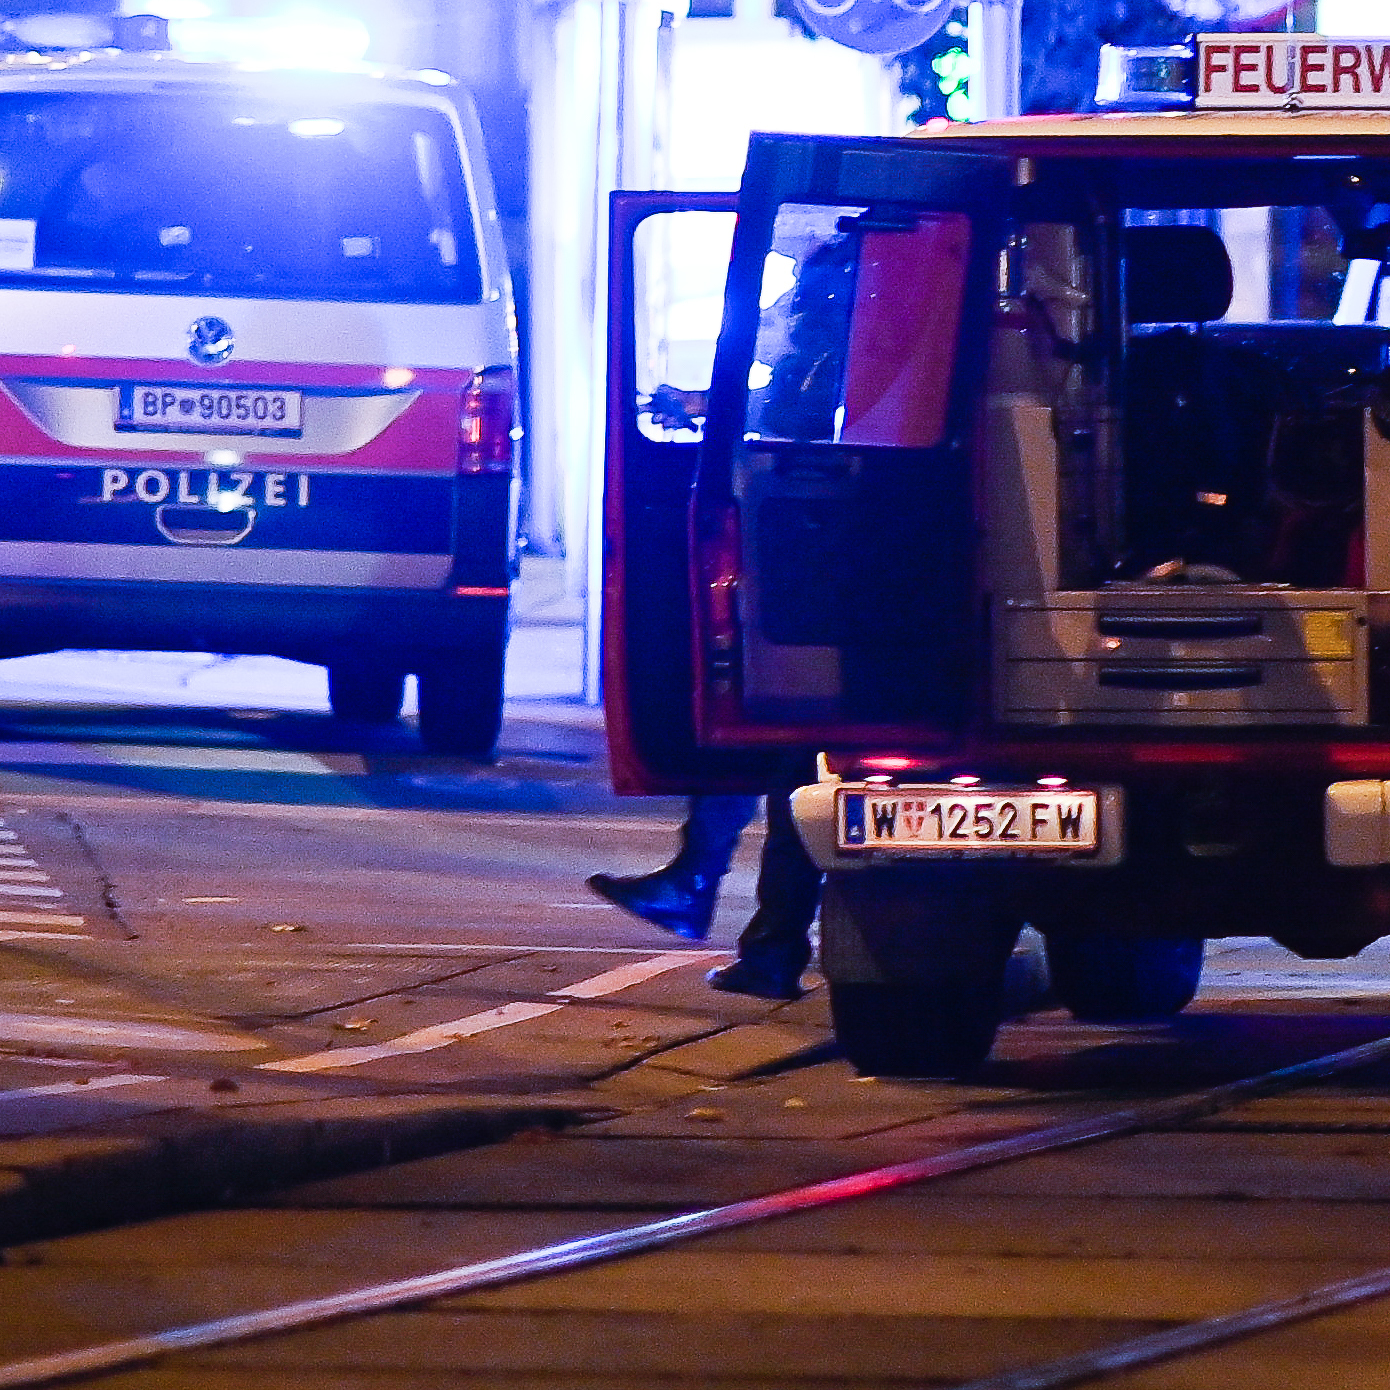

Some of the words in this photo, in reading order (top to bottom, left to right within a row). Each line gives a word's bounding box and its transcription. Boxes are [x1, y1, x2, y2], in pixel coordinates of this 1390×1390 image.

[143, 391, 176, 417] BP
[200, 394, 286, 421] 90503
[102, 468, 310, 507] POLIZEI
[871, 801, 898, 839] W
[929, 801, 1020, 840] 1252
[1030, 802, 1083, 840] FW
